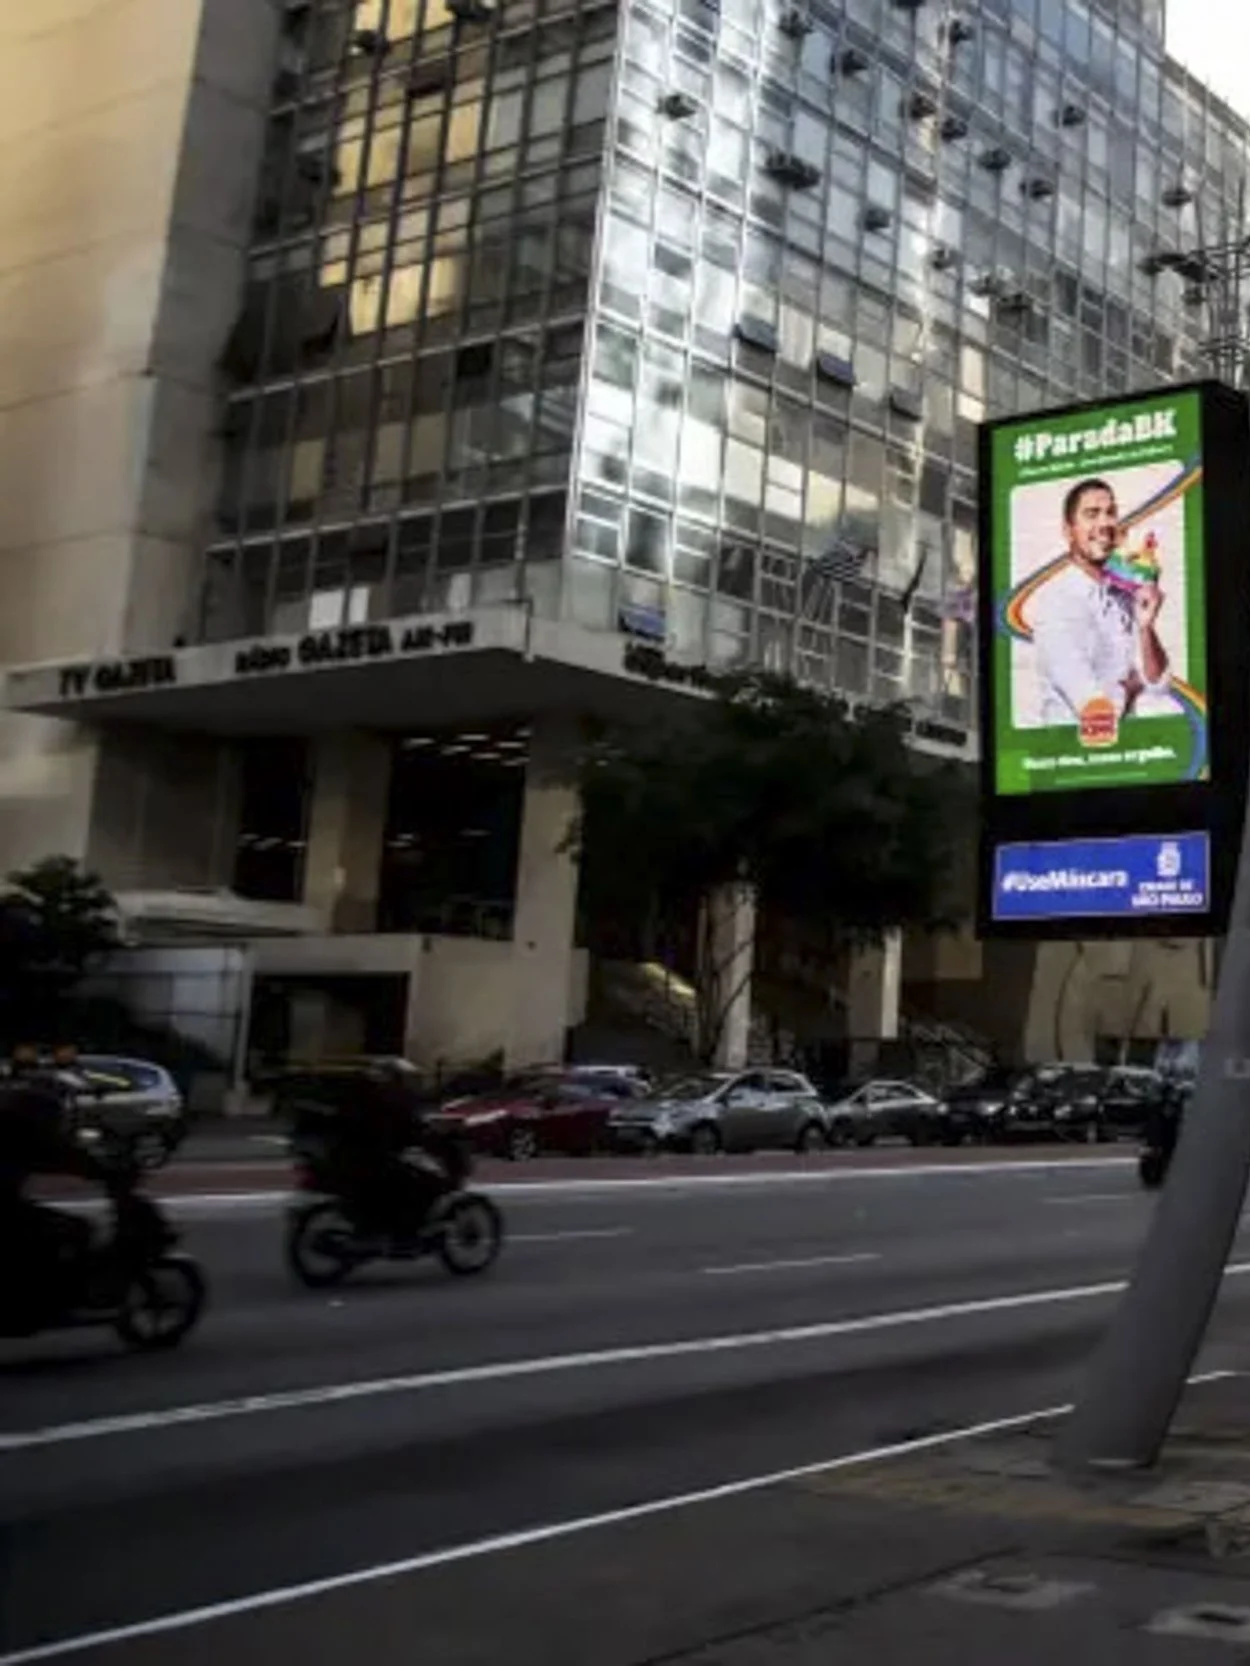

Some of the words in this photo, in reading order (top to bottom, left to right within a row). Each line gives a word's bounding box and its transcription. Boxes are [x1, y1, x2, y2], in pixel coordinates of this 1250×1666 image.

[1014, 407, 1177, 461] #ParadaBK
[298, 624, 393, 664] GAZETA
[59, 665, 91, 696] TV
[95, 655, 177, 690] GAZETA
